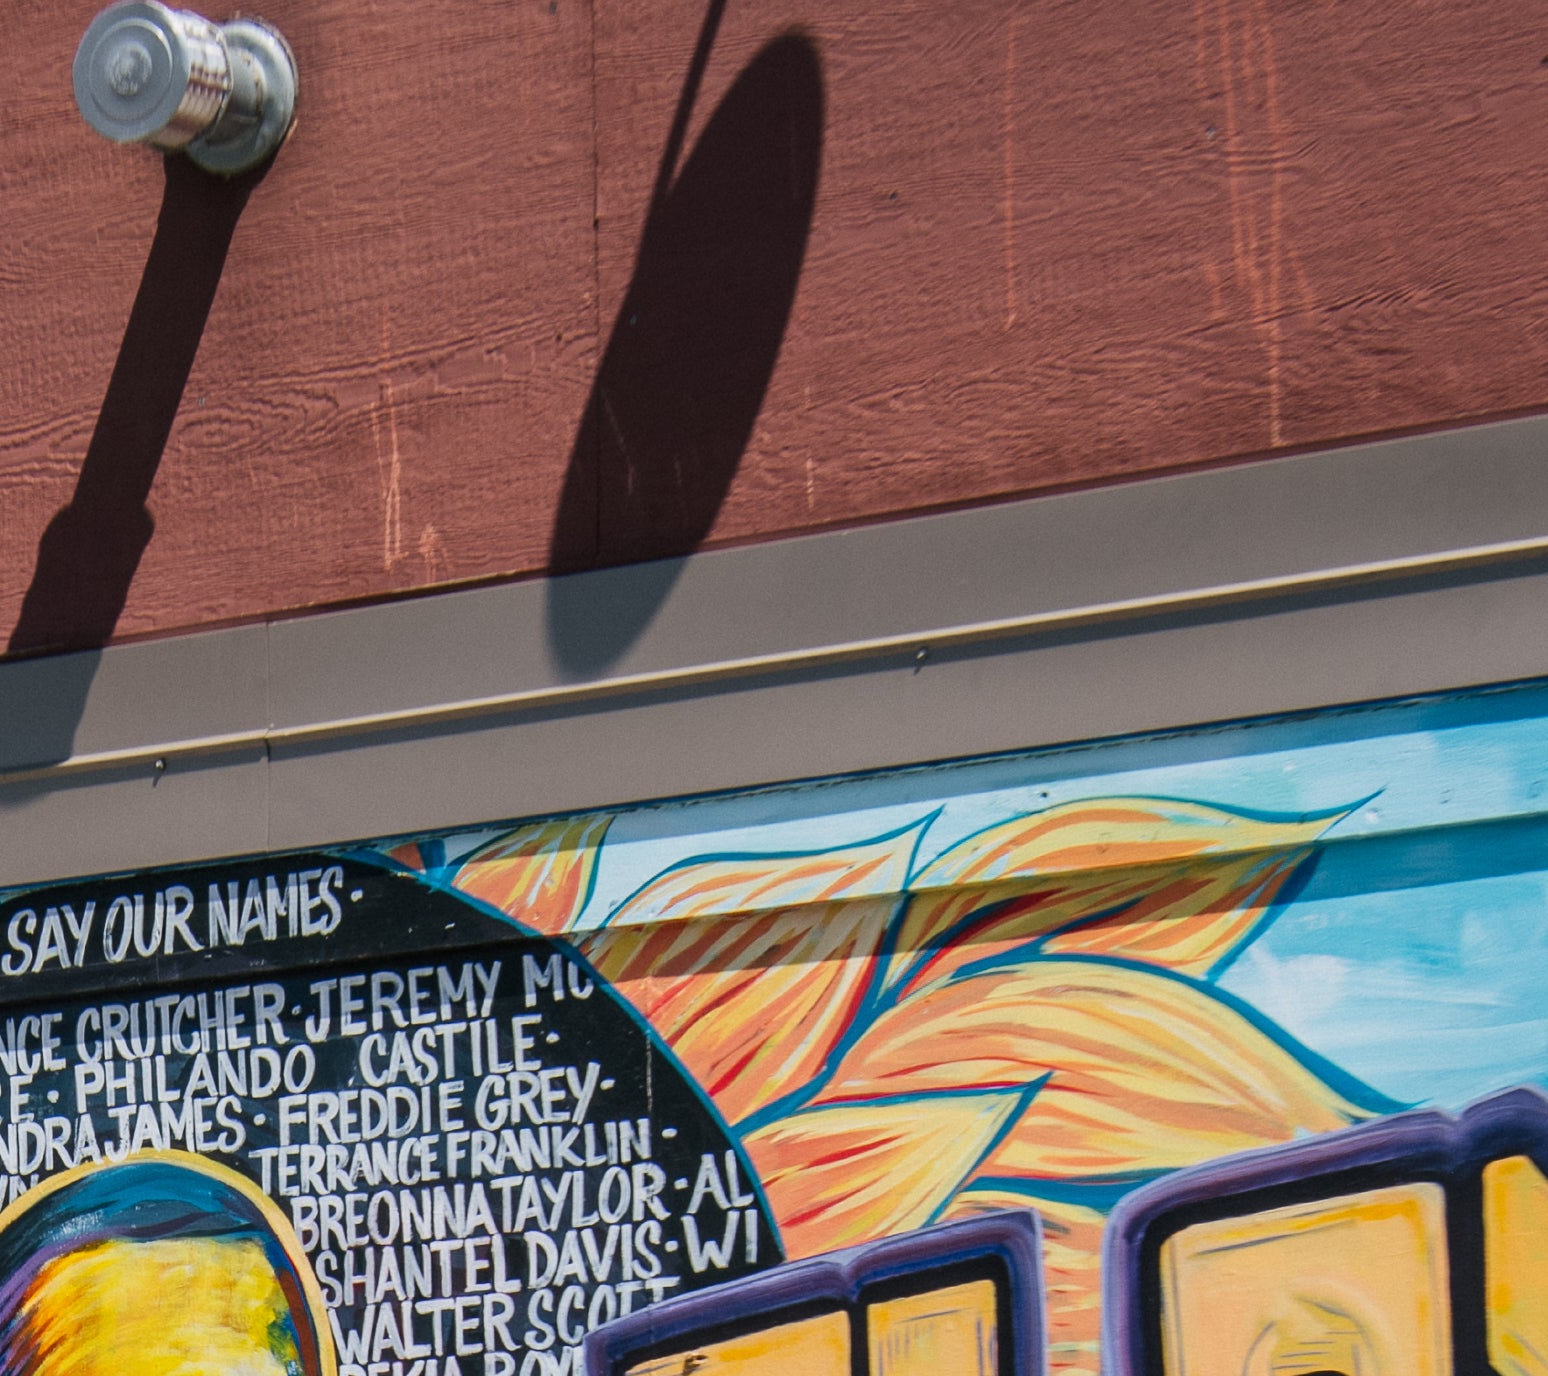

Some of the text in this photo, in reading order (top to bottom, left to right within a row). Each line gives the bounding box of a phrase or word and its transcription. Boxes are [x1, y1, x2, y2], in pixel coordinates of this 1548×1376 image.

[2, 866, 345, 977] SAY OUR NAMES
[76, 983, 291, 1064] CRUTCHER
[305, 961, 503, 1045] JEREMY
[74, 1044, 317, 1115] PHILANDO
[359, 1013, 544, 1088] CASTILE
[104, 1096, 248, 1157] JAMES
[278, 1080, 465, 1147] FREDDIE
[475, 1061, 601, 1131] GREY
[248, 1140, 439, 1198] TERRANCE
[447, 1117, 653, 1180] FRANKLIN
[290, 1149, 755, 1254] BREONNA TAYLOR AL
[314, 1233, 523, 1309] SHANTEL
[525, 1220, 663, 1290] DAVIS
[680, 1207, 760, 1275] WI
[326, 1293, 523, 1366] WALTER
[524, 1275, 681, 1351] SCOTT
